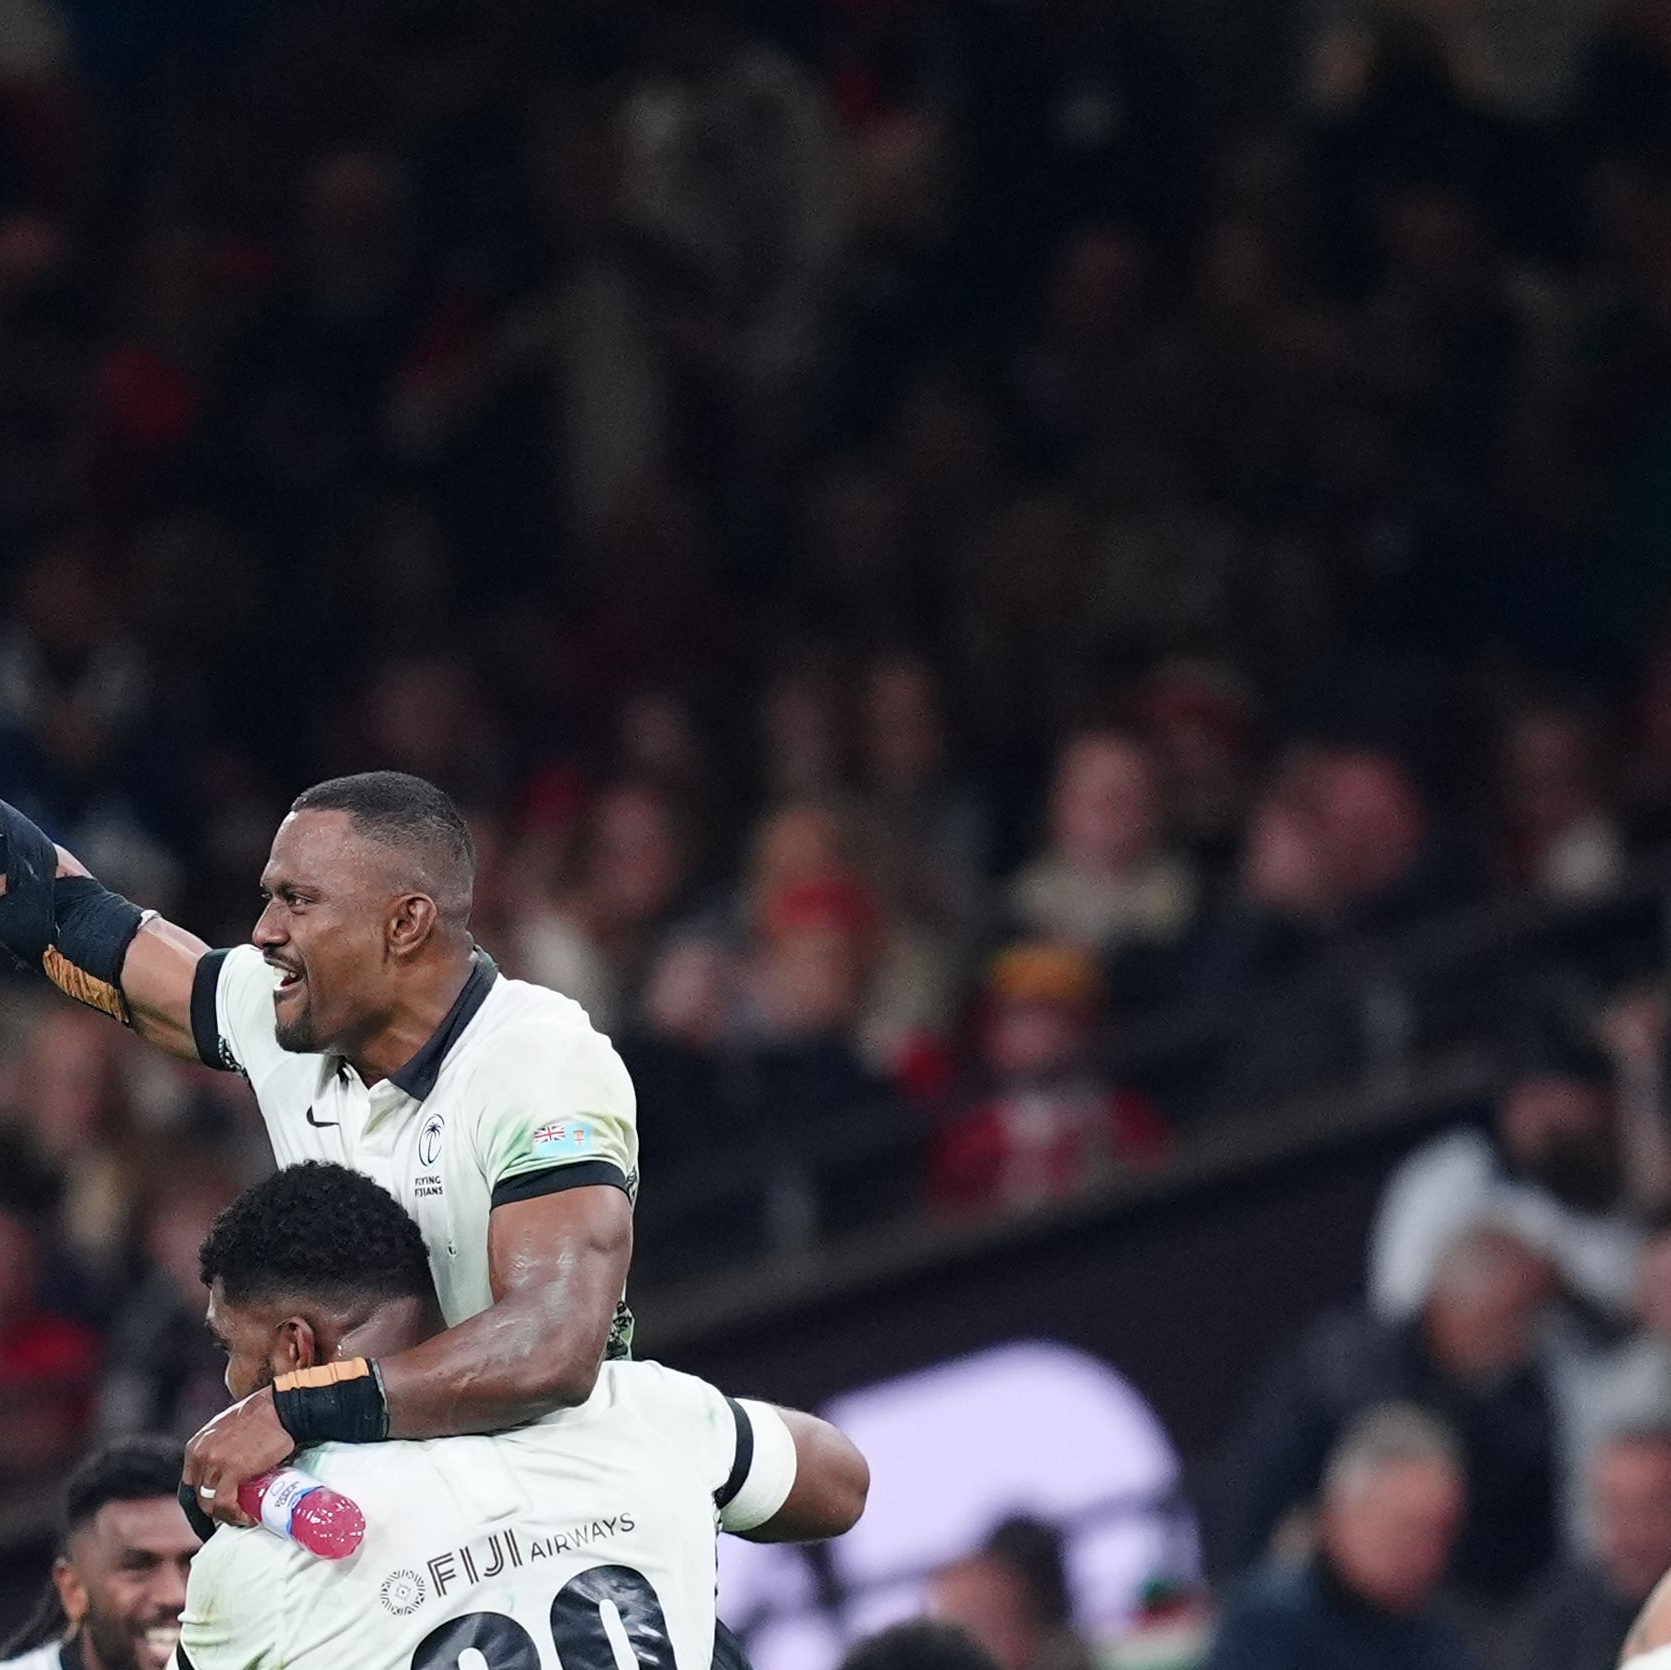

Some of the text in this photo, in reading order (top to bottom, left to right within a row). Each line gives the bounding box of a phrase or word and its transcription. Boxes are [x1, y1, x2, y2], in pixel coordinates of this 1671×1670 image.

[414, 1186, 443, 1198] FJIANS
[427, 1512, 635, 1597] FIJI AIRWAYS
